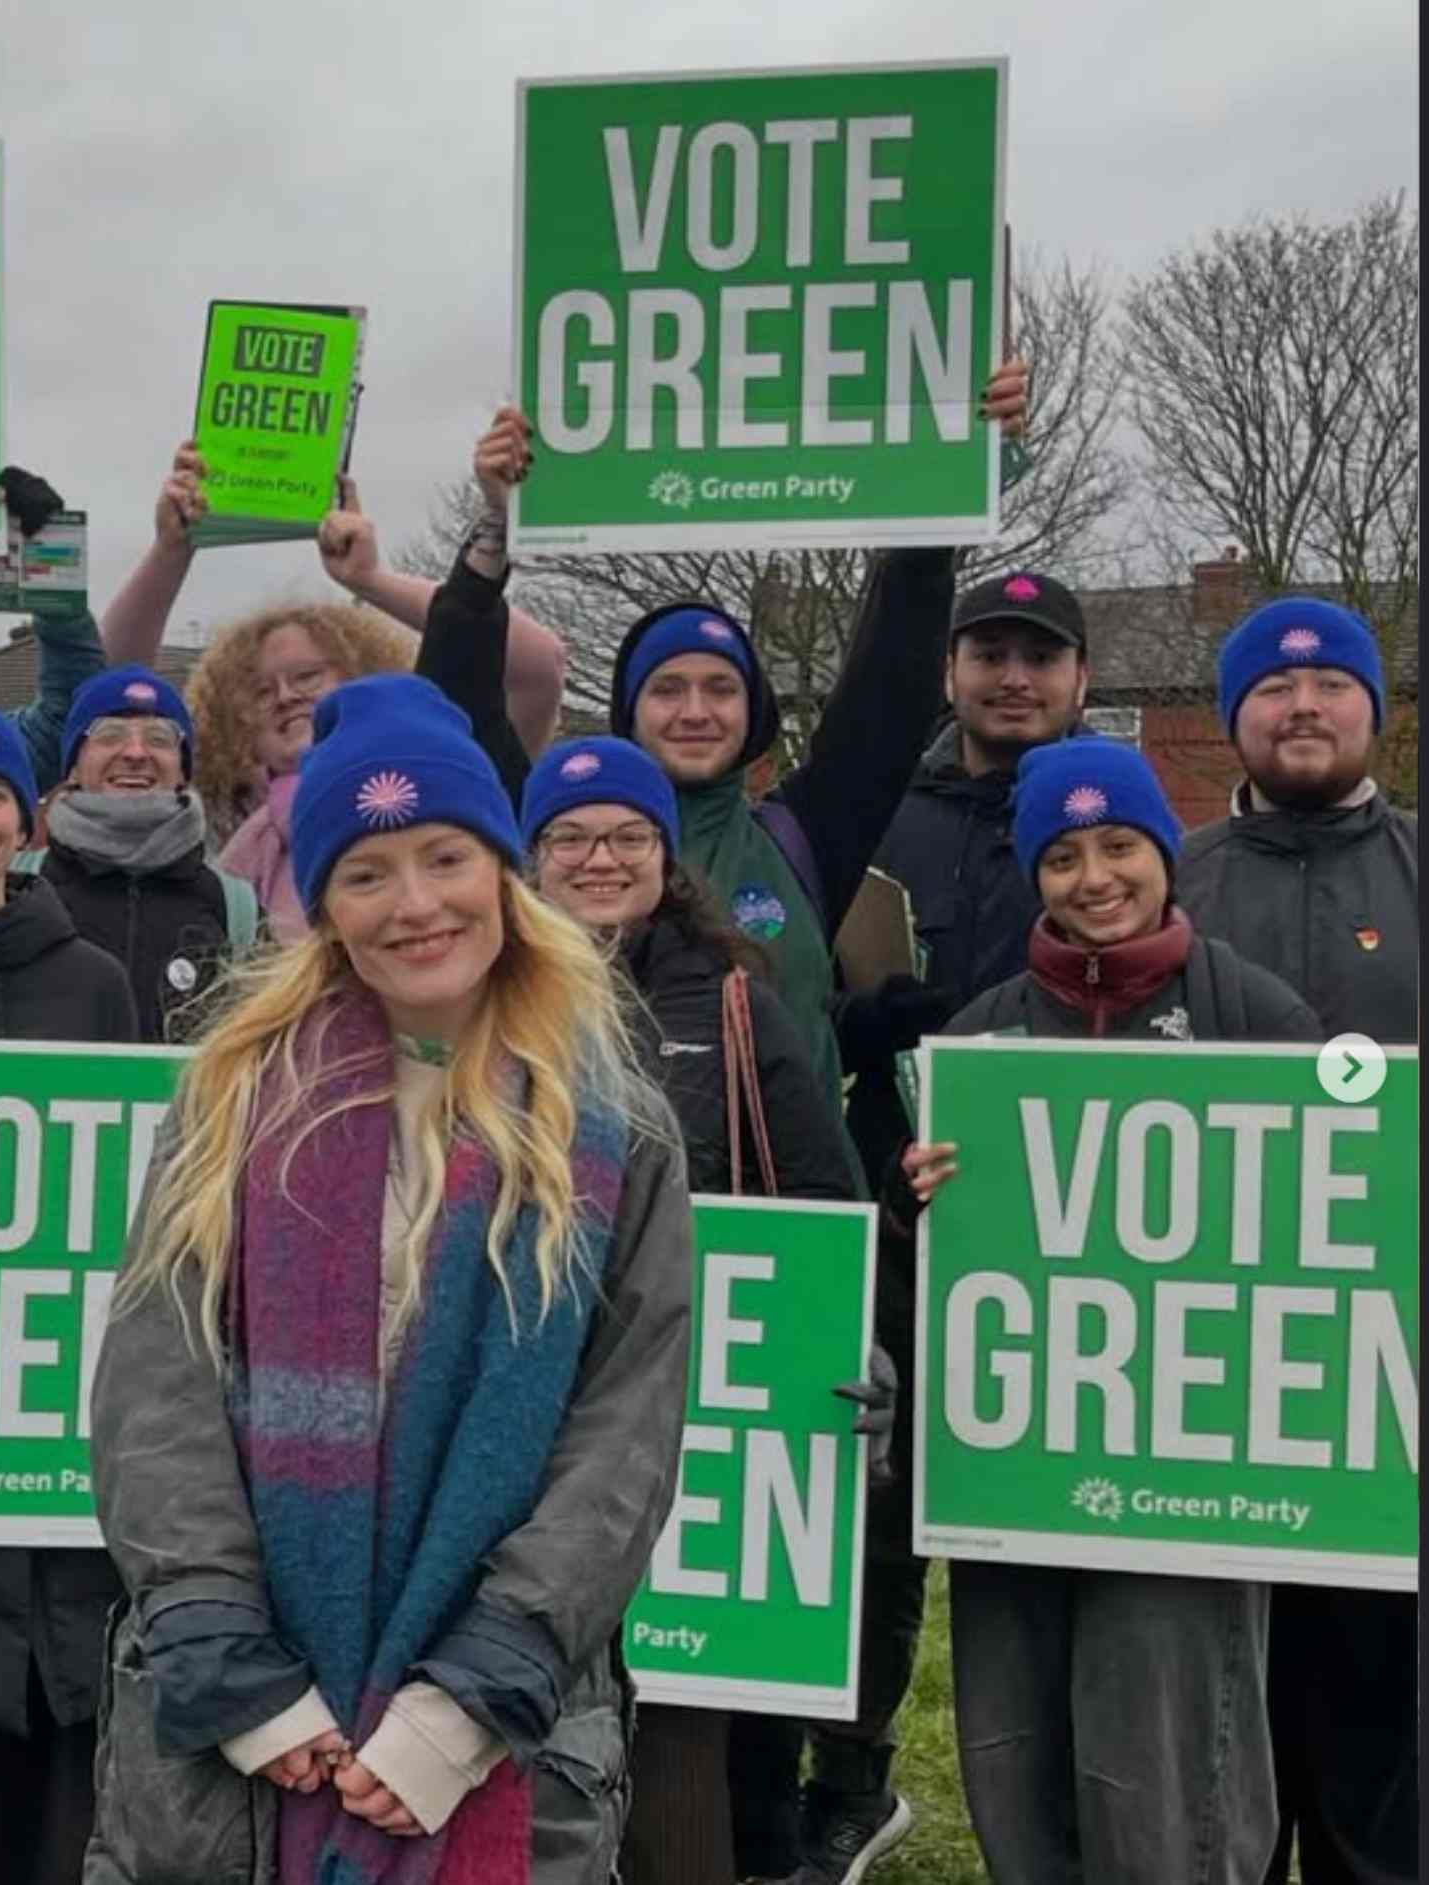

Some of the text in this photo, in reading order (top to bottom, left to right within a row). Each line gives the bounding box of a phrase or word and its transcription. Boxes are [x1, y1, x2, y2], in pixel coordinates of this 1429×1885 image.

[603, 115, 913, 272] VOTE
[243, 330, 317, 373] VOTE
[536, 278, 974, 454] GREEN
[211, 381, 332, 437] GREEN
[700, 474, 855, 505] Green Party
[1019, 1098, 1380, 1271] VOTE
[944, 1270, 1418, 1475] GREEN
[1130, 1488, 1312, 1531] Green Party
[632, 1621, 708, 1659] Party
